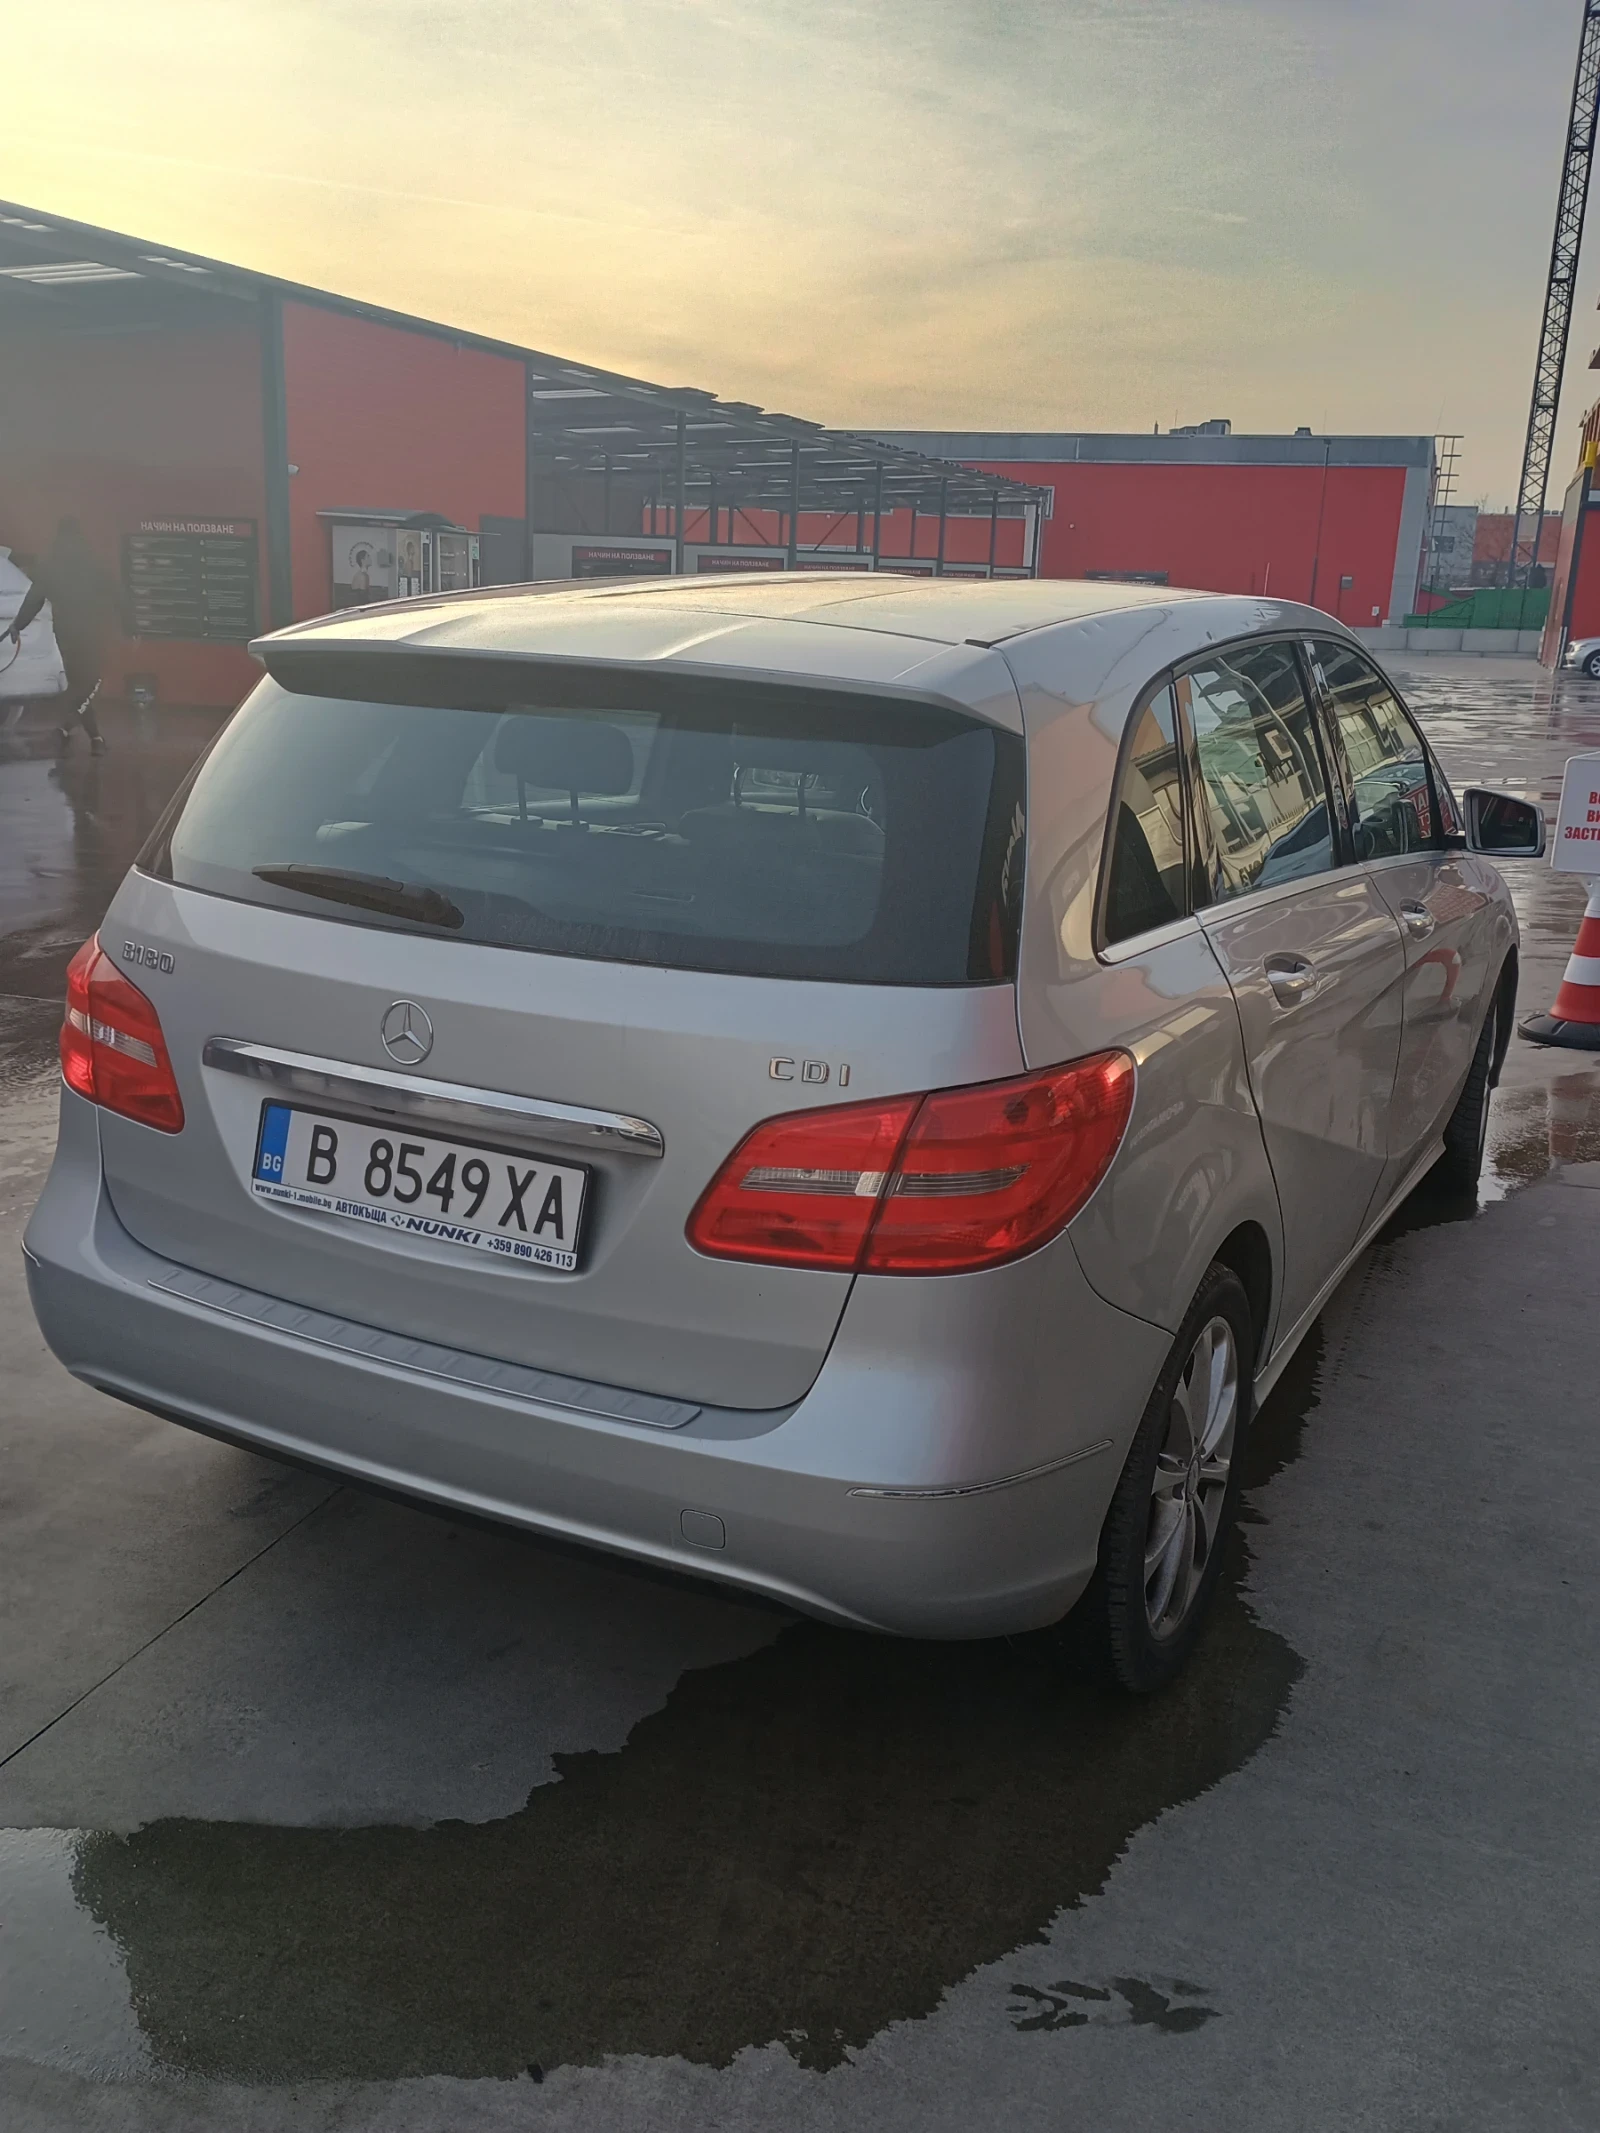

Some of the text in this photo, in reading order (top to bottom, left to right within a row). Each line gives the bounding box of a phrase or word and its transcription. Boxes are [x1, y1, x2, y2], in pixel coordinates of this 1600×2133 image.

[140, 521, 234, 534] НАЧИН НА ПОЛЗВАНЕ
[588, 551, 655, 561] НАЧИН НА ПОЛЗВАНЕ
[1589, 791, 1600, 804] В
[1564, 826, 1600, 841] ЗАСТ
[122, 940, 175, 974] B180
[769, 1057, 850, 1087] CDI
[262, 1153, 282, 1172] BG
[306, 1124, 564, 1240] B 8549 XA
[255, 1183, 332, 1209] www.nunki-1.mobile.bg
[335, 1200, 387, 1224] АВТОКЪЩА
[405, 1218, 573, 1268] NUNKI +359 890 426 113
